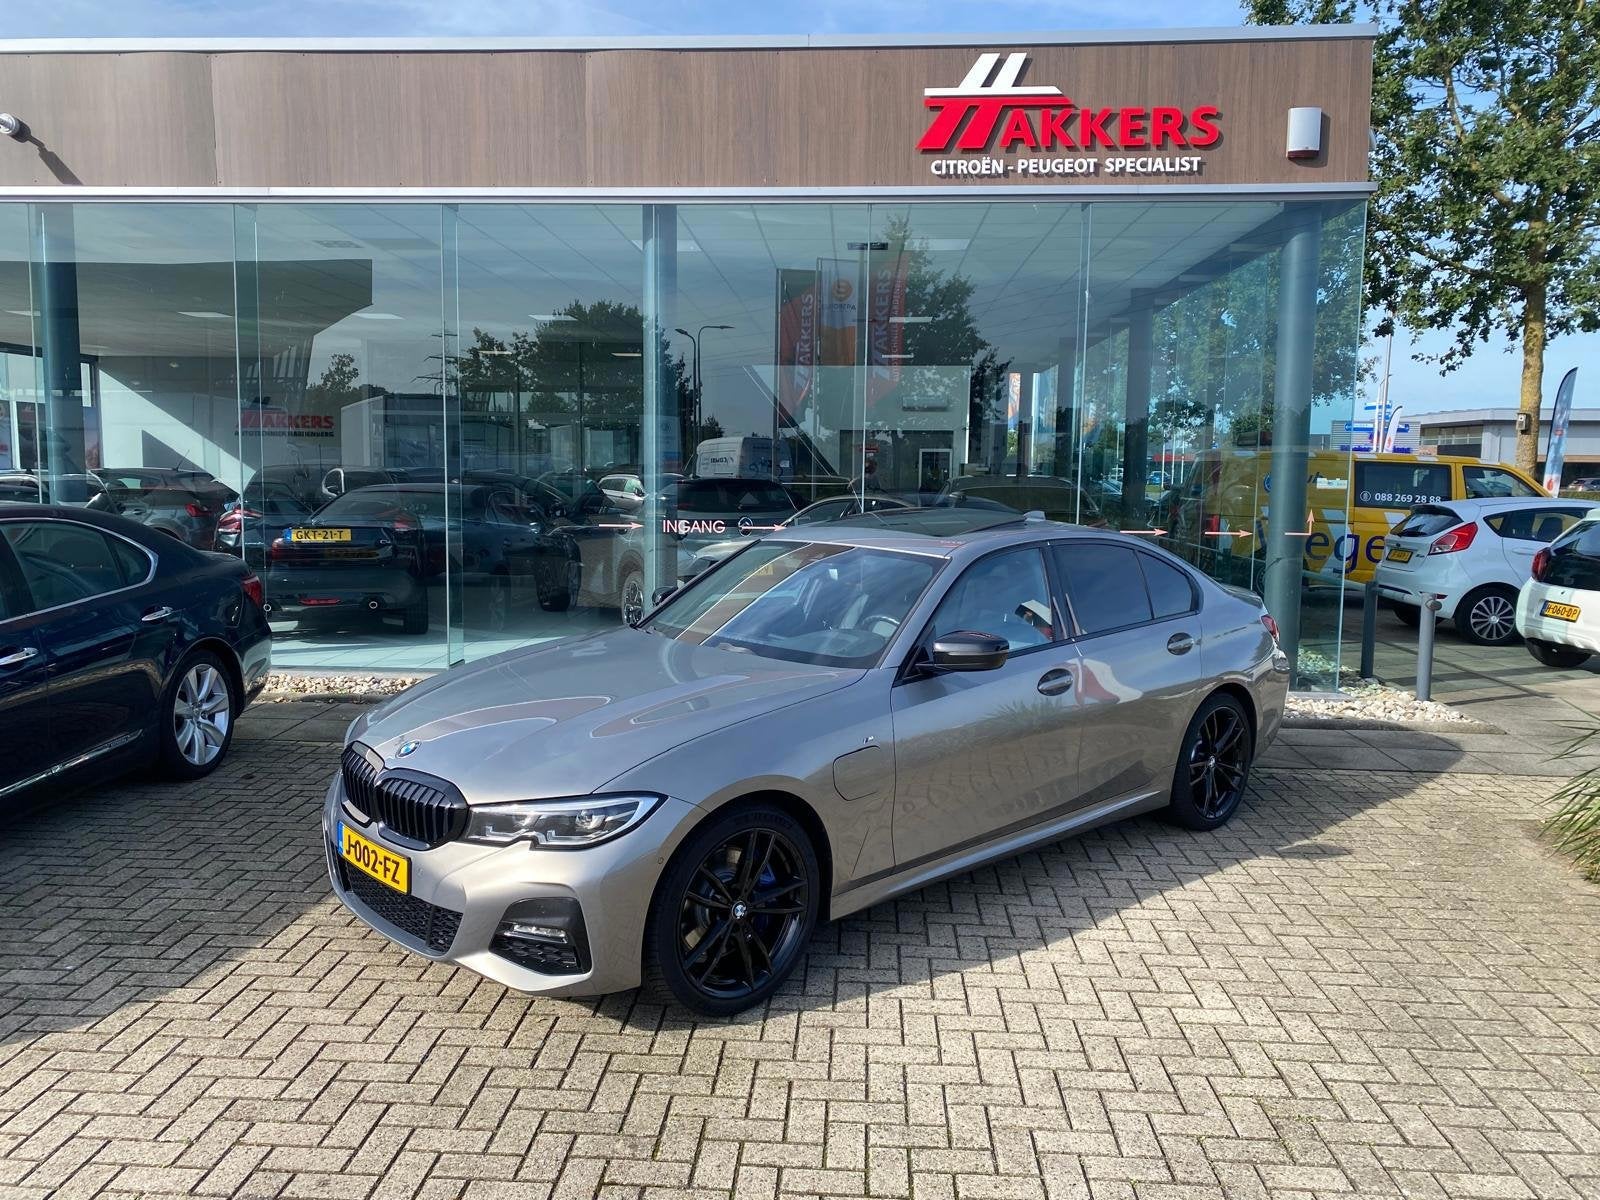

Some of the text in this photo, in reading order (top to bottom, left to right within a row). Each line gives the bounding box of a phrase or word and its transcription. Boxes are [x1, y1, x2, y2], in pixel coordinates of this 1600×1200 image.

[930, 156, 1004, 175] CITROËN
[1017, 157, 1098, 174] PEUGEOT
[1104, 156, 1202, 172] SPECIALIST
[1374, 492, 1441, 504] 088 269 28 88
[662, 520, 726, 533] INGANG
[295, 530, 344, 540] GKT-21-T
[345, 834, 401, 885] J-002-FZ
